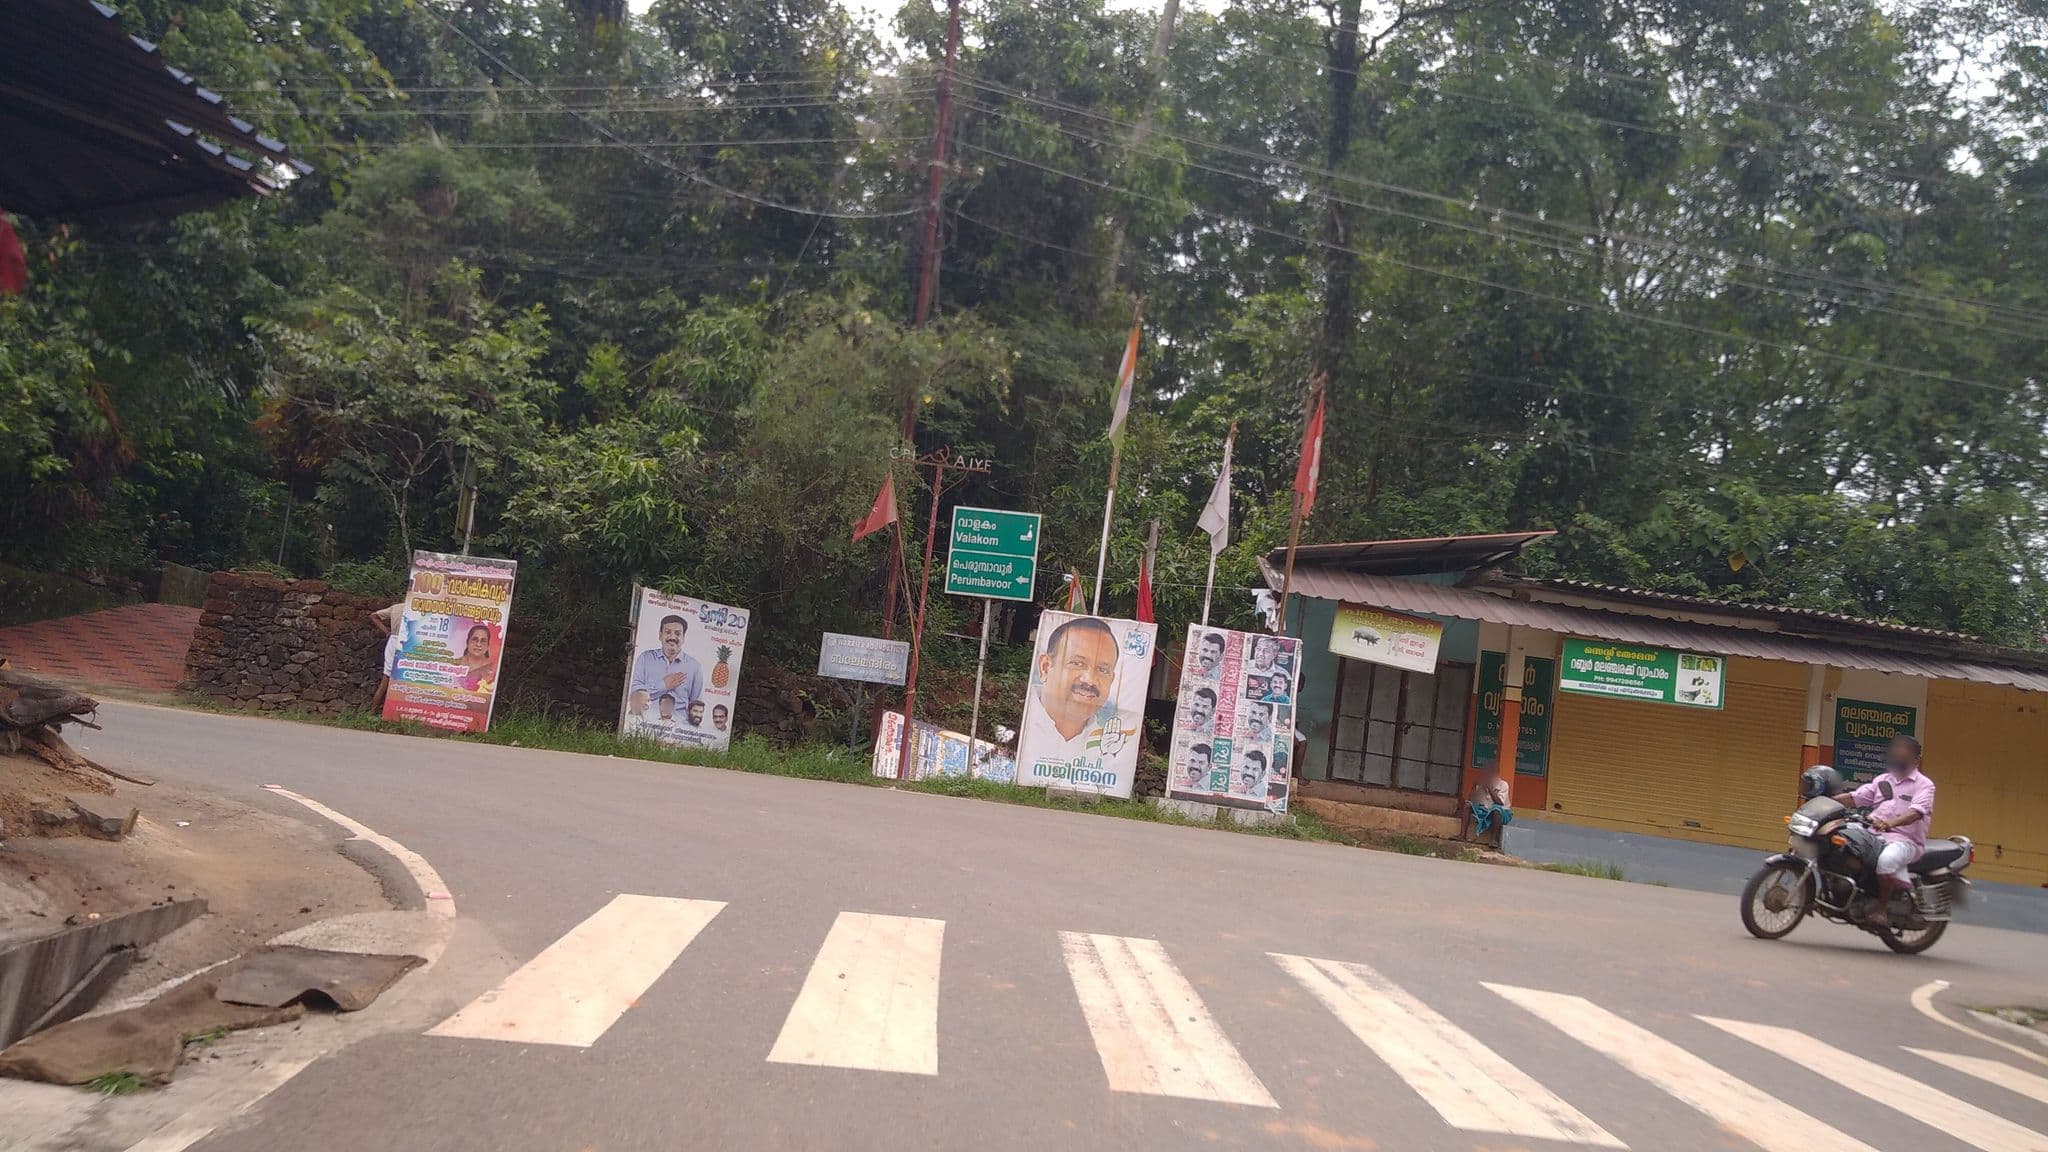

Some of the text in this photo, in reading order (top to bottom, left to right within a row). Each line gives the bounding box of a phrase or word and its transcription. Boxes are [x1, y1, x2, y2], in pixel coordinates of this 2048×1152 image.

[889, 447, 916, 461] CPI
[958, 517, 997, 531] വാളകം
[955, 531, 999, 546] Valakom
[952, 560, 1013, 577] പെരുമ്പാവൂർ
[950, 573, 1013, 589] Perumbavoor
[440, 617, 450, 632] 18
[728, 613, 747, 629] 20
[1616, 650, 1659, 661] തോമസ്
[1841, 706, 1911, 726] മലഞ്ചരക്ക്
